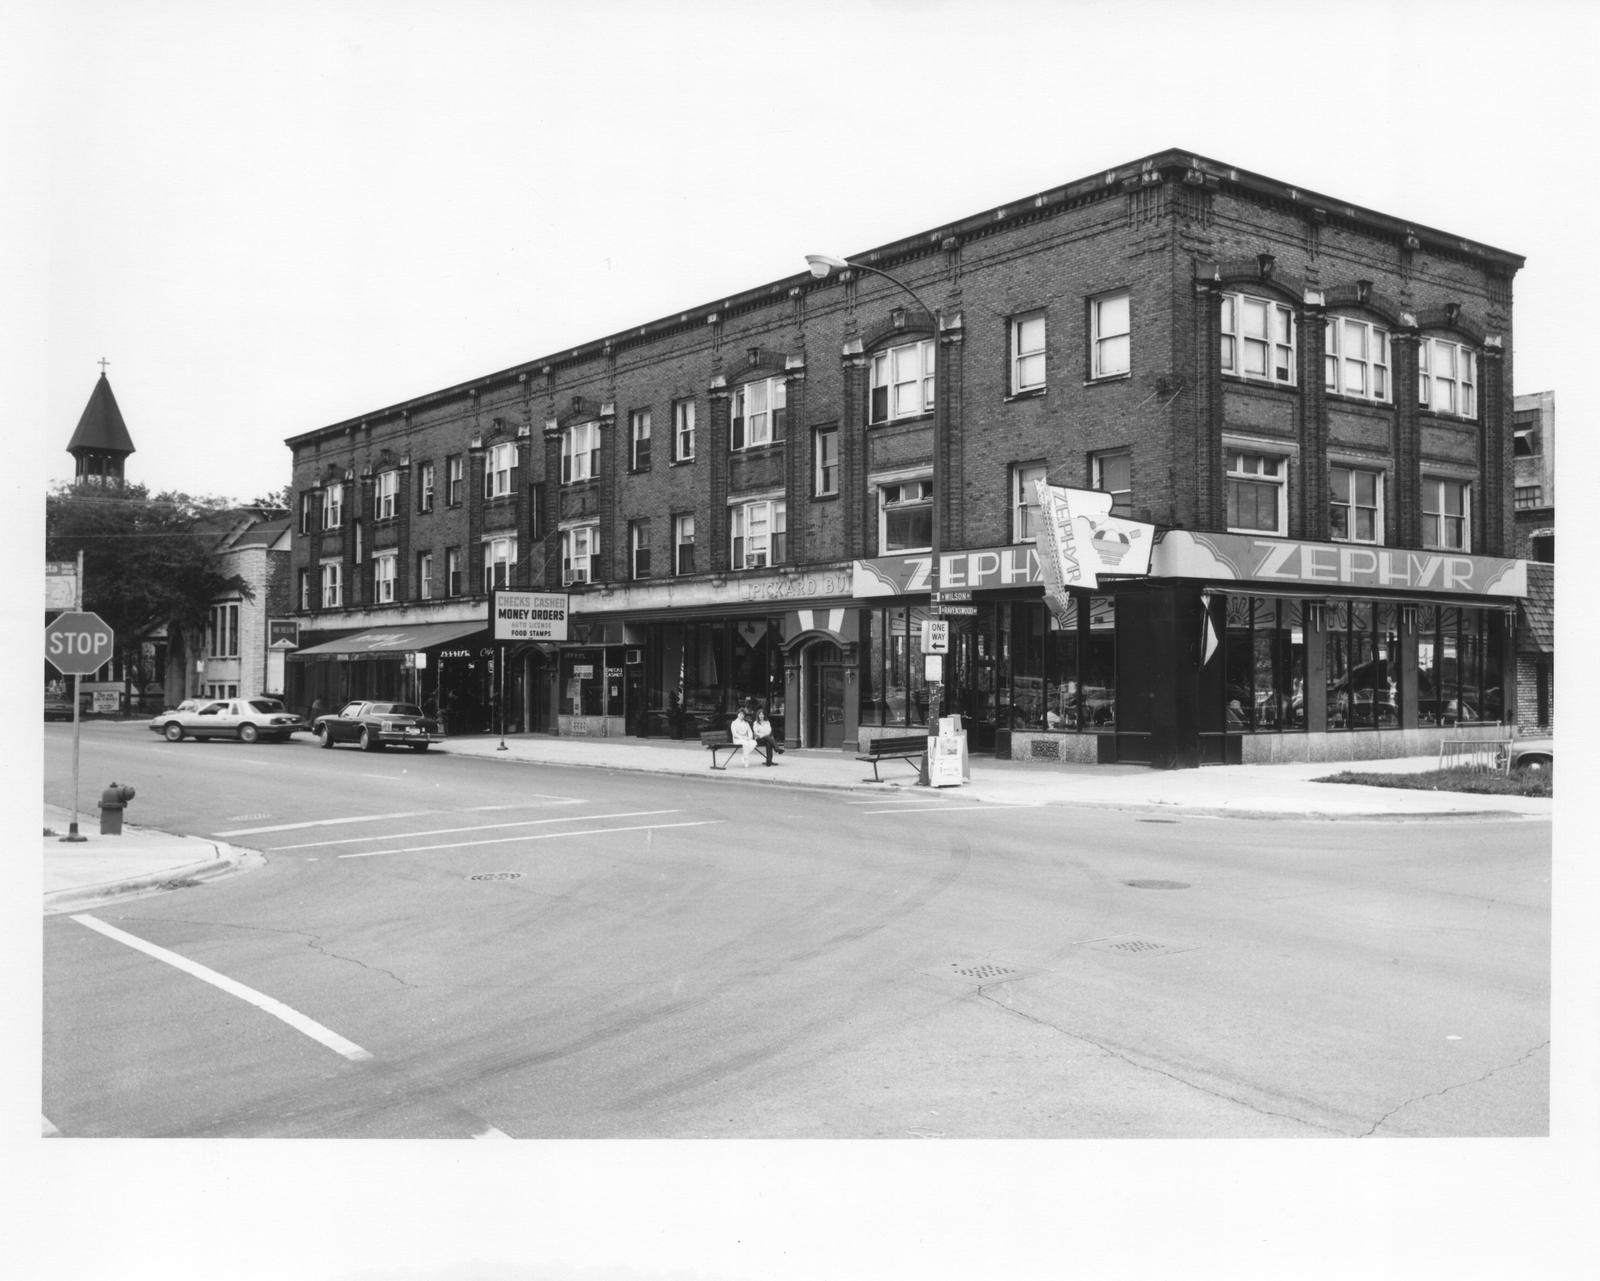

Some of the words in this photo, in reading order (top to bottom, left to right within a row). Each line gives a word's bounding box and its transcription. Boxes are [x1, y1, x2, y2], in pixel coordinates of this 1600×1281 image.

[1052, 487, 1082, 584] ZEPHYR
[903, 548, 1044, 591] ZEPH
[1252, 540, 1473, 590] ZEPHYR
[498, 596, 531, 608] CHECKS
[533, 597, 566, 609] CASHED
[498, 608, 530, 620] MONEY
[531, 609, 565, 621] ORDERS
[511, 629, 527, 637] FOOD
[931, 623, 946, 632] ONE
[50, 631, 109, 655] STOP
[931, 633, 946, 641] WAY
